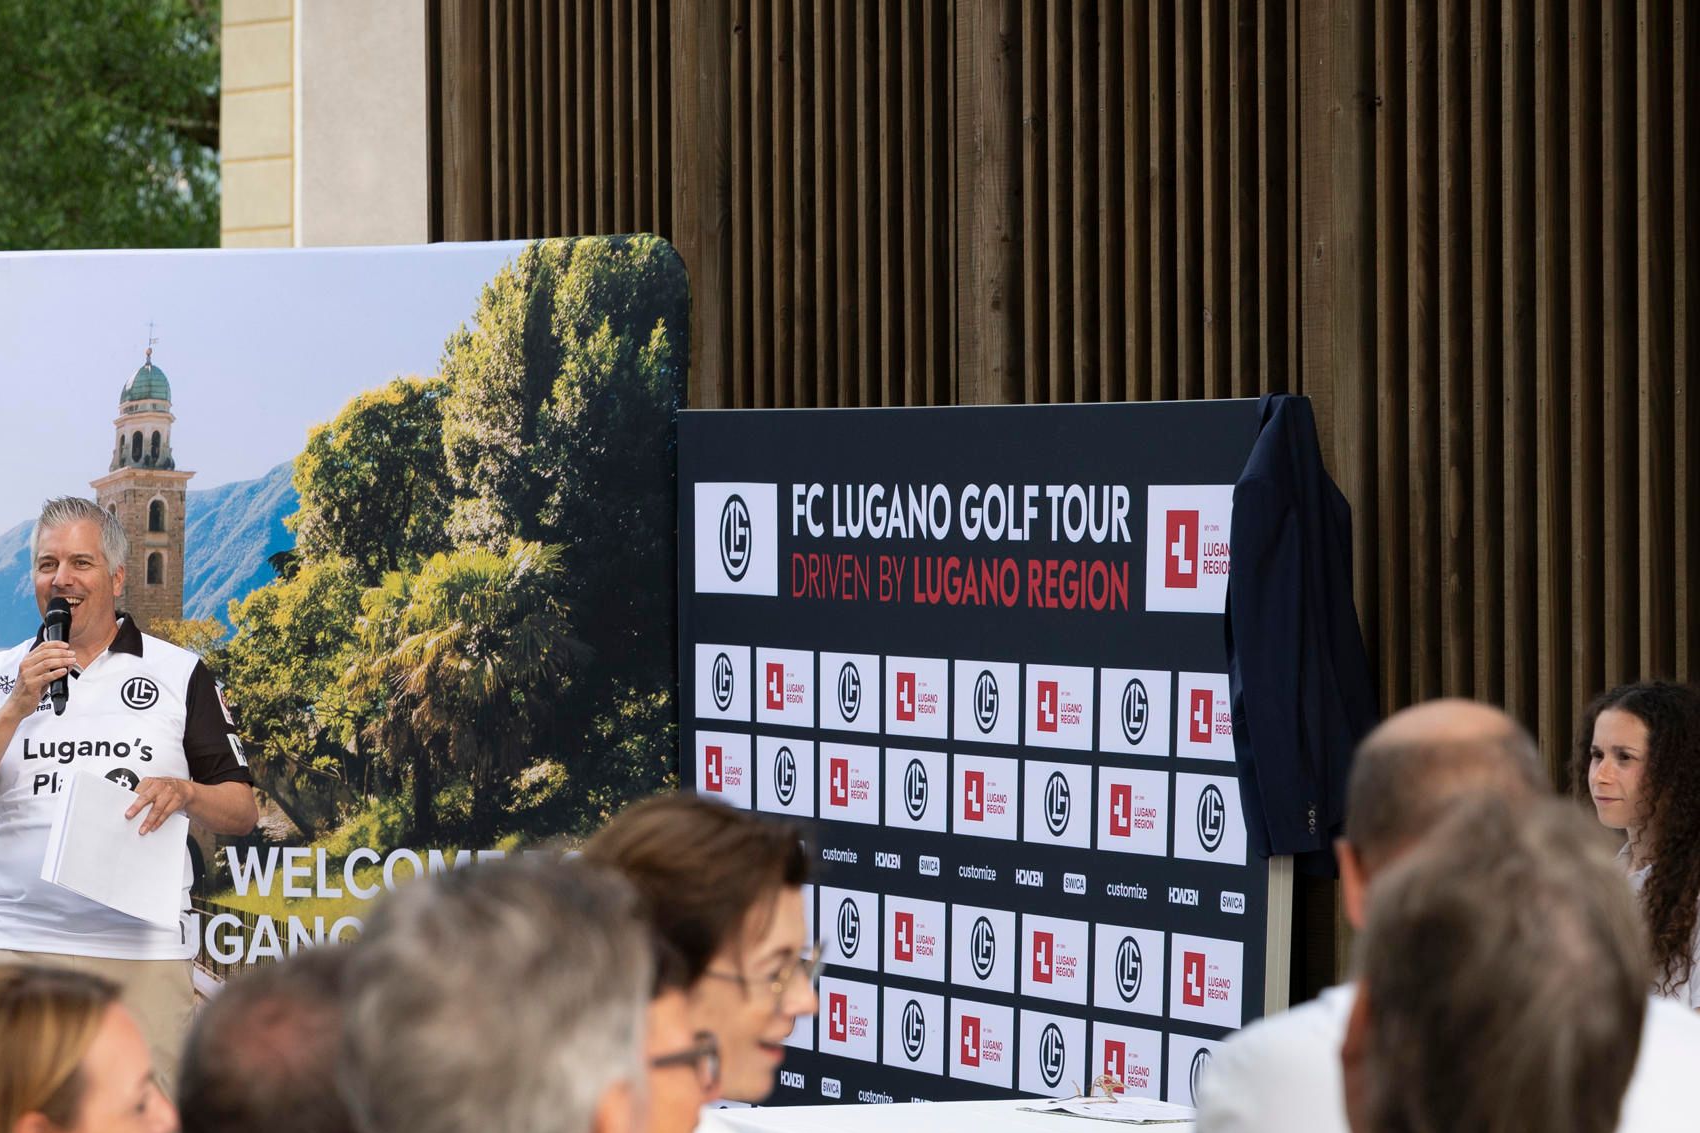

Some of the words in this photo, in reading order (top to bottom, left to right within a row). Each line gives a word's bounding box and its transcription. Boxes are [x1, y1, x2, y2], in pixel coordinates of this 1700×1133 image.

[792, 483, 825, 538] FC
[833, 483, 952, 541] LUGANO
[960, 483, 1040, 542] GOLF
[1046, 483, 1132, 543] TOUR
[1203, 542, 1231, 557] LUGAN
[792, 552, 870, 601] DRIVEN
[880, 555, 906, 603] BY
[913, 556, 1021, 608] LUGANO
[1028, 560, 1129, 612] REGION
[786, 683, 805, 694] LUGANO
[786, 693, 804, 704] REGION
[918, 693, 938, 704] LUGANO
[918, 703, 936, 715] REGION
[1060, 703, 1082, 714] LUGANO
[1060, 714, 1080, 725] REGION
[1215, 724, 1232, 735] REGIO
[724, 766, 743, 776] LUGANO
[724, 776, 741, 786] REGION
[850, 779, 870, 791] LUGANO
[850, 790, 868, 801] REGION
[987, 793, 1008, 804] LUGANO
[987, 804, 1005, 815] REGION
[1134, 807, 1157, 819] LUGANO
[1134, 818, 1154, 830] REGION
[822, 847, 858, 864] customize
[875, 852, 901, 870] HOWDEN
[920, 859, 939, 872] SWICA
[226, 845, 505, 900] WELCO
[958, 865, 997, 881] customize
[1015, 868, 1044, 888] HOWDEN
[1064, 877, 1084, 890] SWICA
[1106, 882, 1148, 900] customize
[1168, 887, 1199, 906] HOWDEN
[1222, 895, 1243, 909] SWICA
[916, 934, 936, 947] LUGANO
[916, 945, 934, 957] REGION
[1055, 955, 1077, 968] LUGANO
[1055, 966, 1075, 979] REGION
[1207, 976, 1231, 989] LUGANO
[1207, 987, 1229, 1001] REGION
[849, 1015, 869, 1028] LUGANO
[849, 1026, 867, 1038] REGION
[982, 1039, 1003, 1052] LUGANO
[982, 1050, 1001, 1063] REGION
[1127, 1064, 1150, 1078] LUGANO
[780, 1070, 805, 1090] HOWDEN
[1127, 1076, 1148, 1089] REGION
[823, 1081, 840, 1094] SWICA
[858, 1089, 894, 1104] customize
